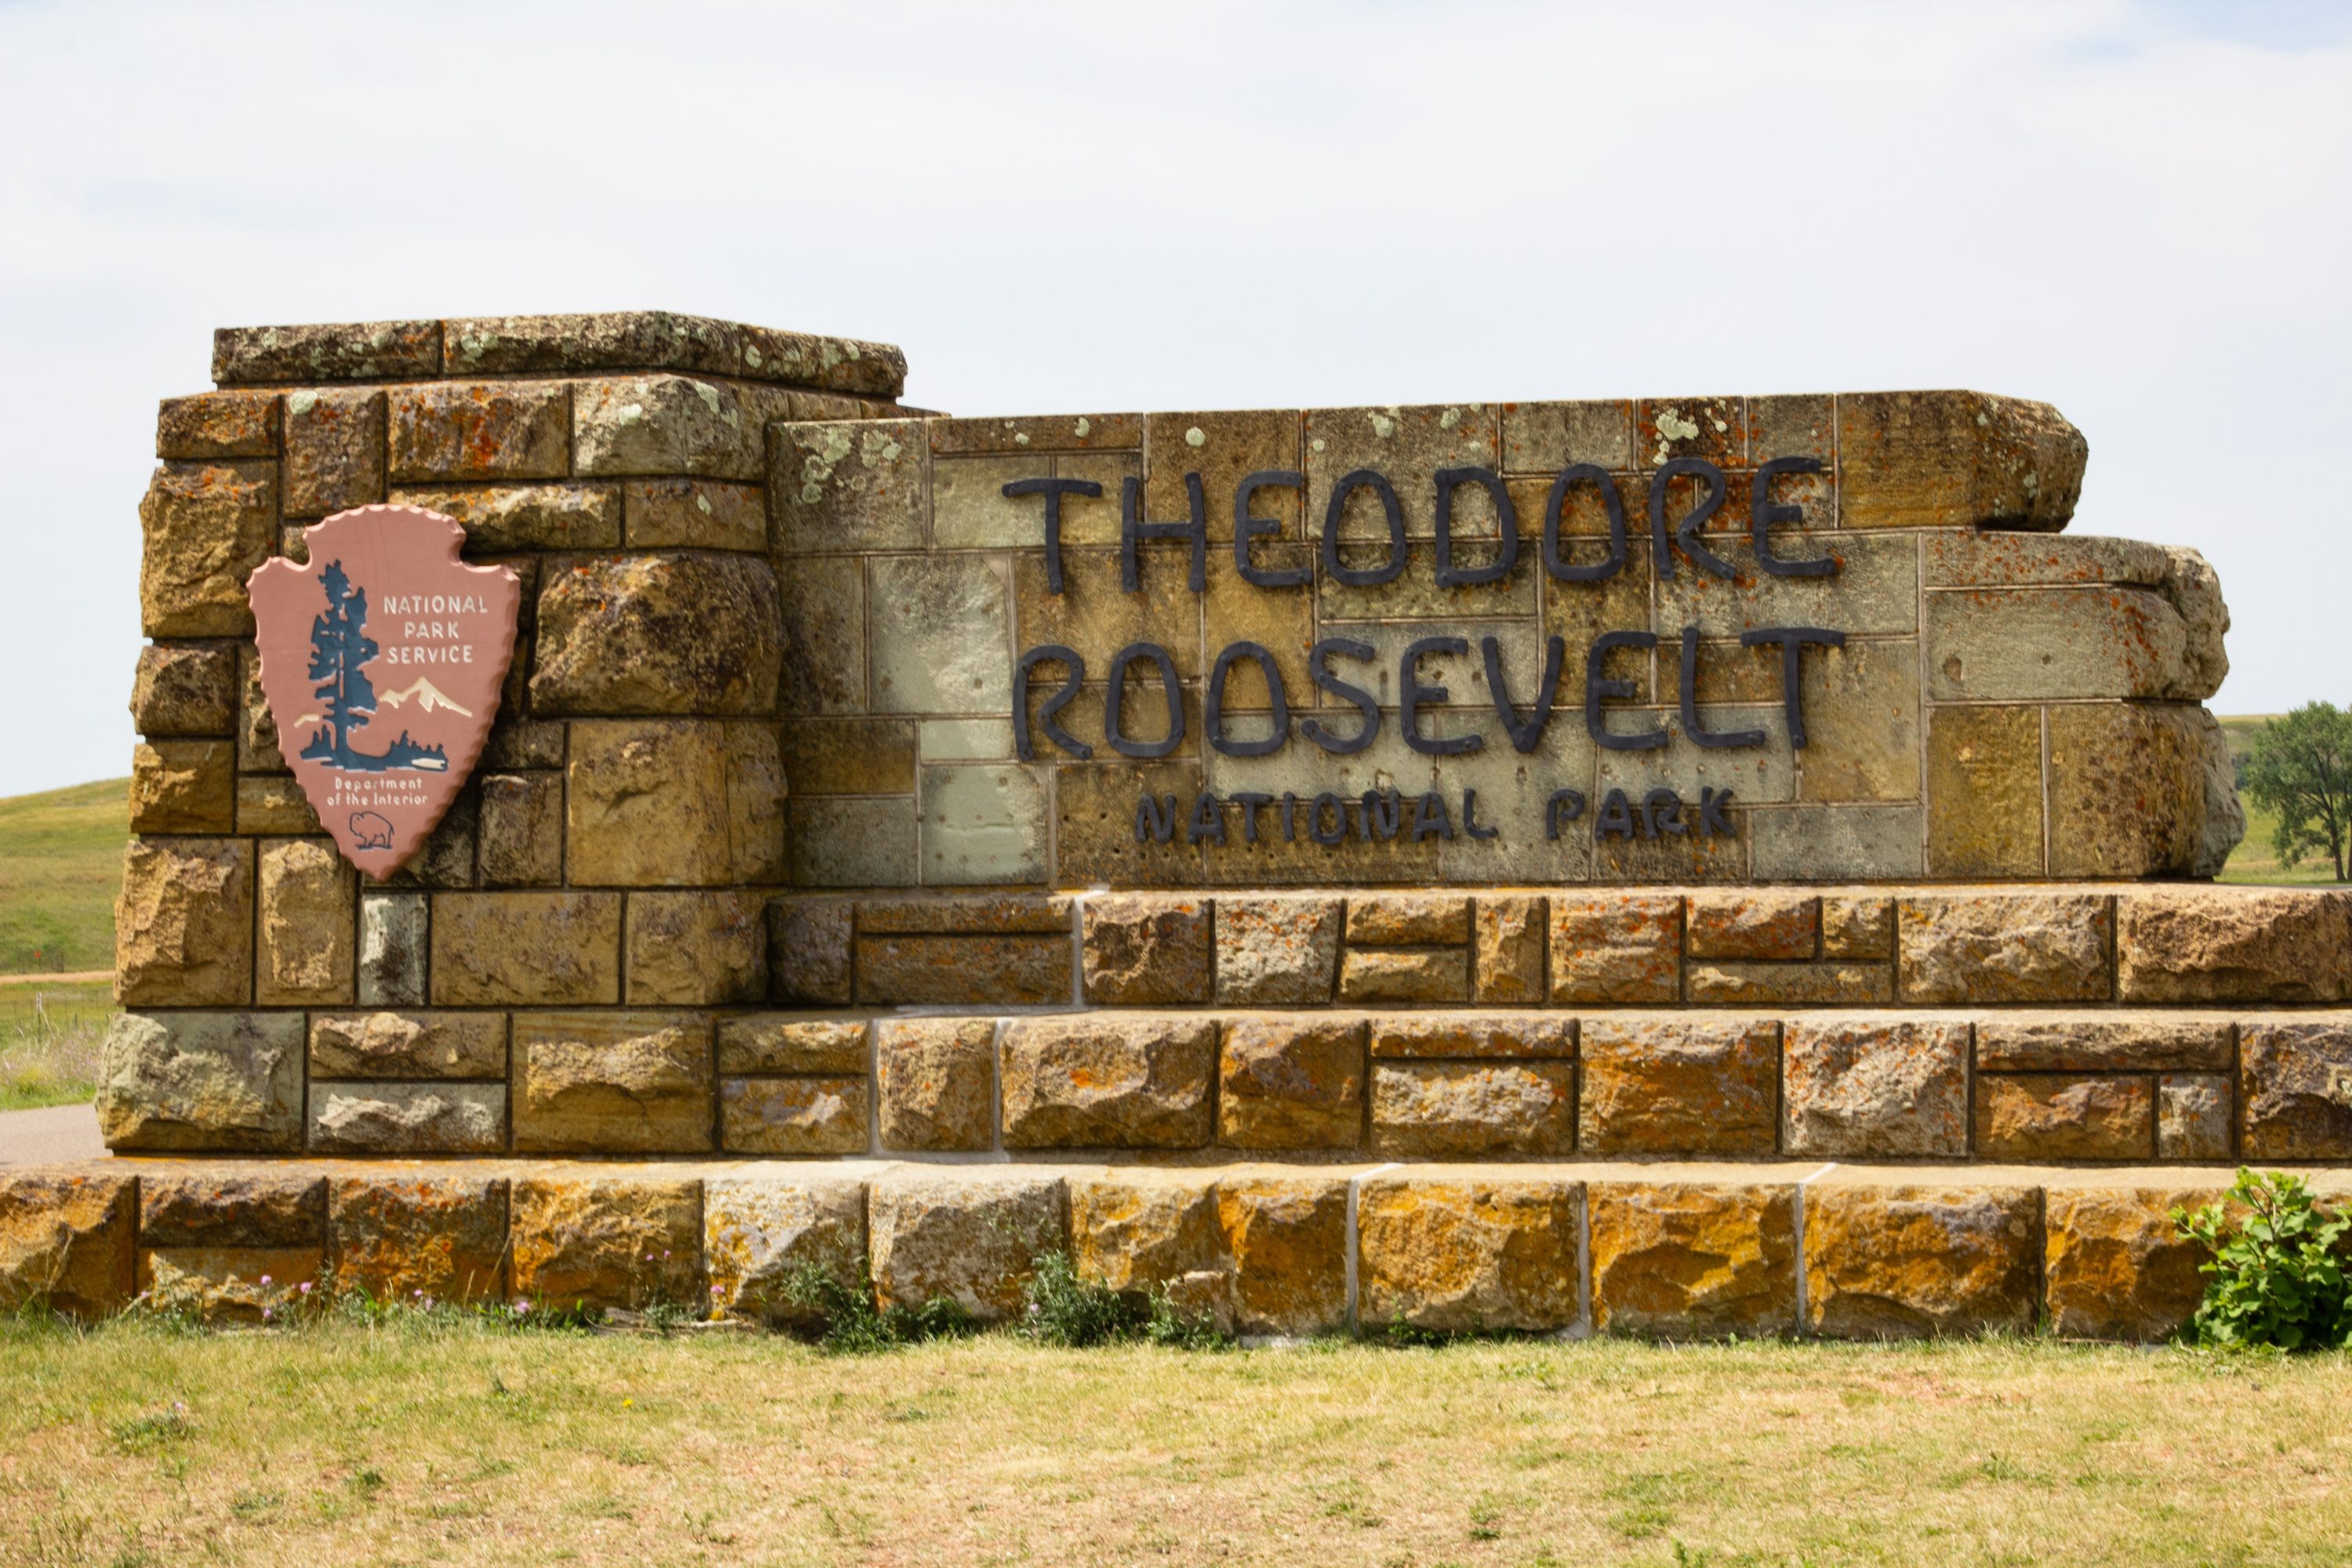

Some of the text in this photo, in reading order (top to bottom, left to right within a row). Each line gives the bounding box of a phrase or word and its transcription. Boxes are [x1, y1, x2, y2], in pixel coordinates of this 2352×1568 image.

[1002, 457, 1837, 594] THEODORE
[383, 595, 488, 615] NATIONAL
[404, 621, 459, 639] PARK
[387, 645, 474, 665] SERVICE
[1012, 627, 1846, 760] ROOSEVELT
[334, 776, 423, 793] Department
[327, 792, 428, 806] of the Interior
[1134, 786, 1737, 848] NATIONAL PARK
